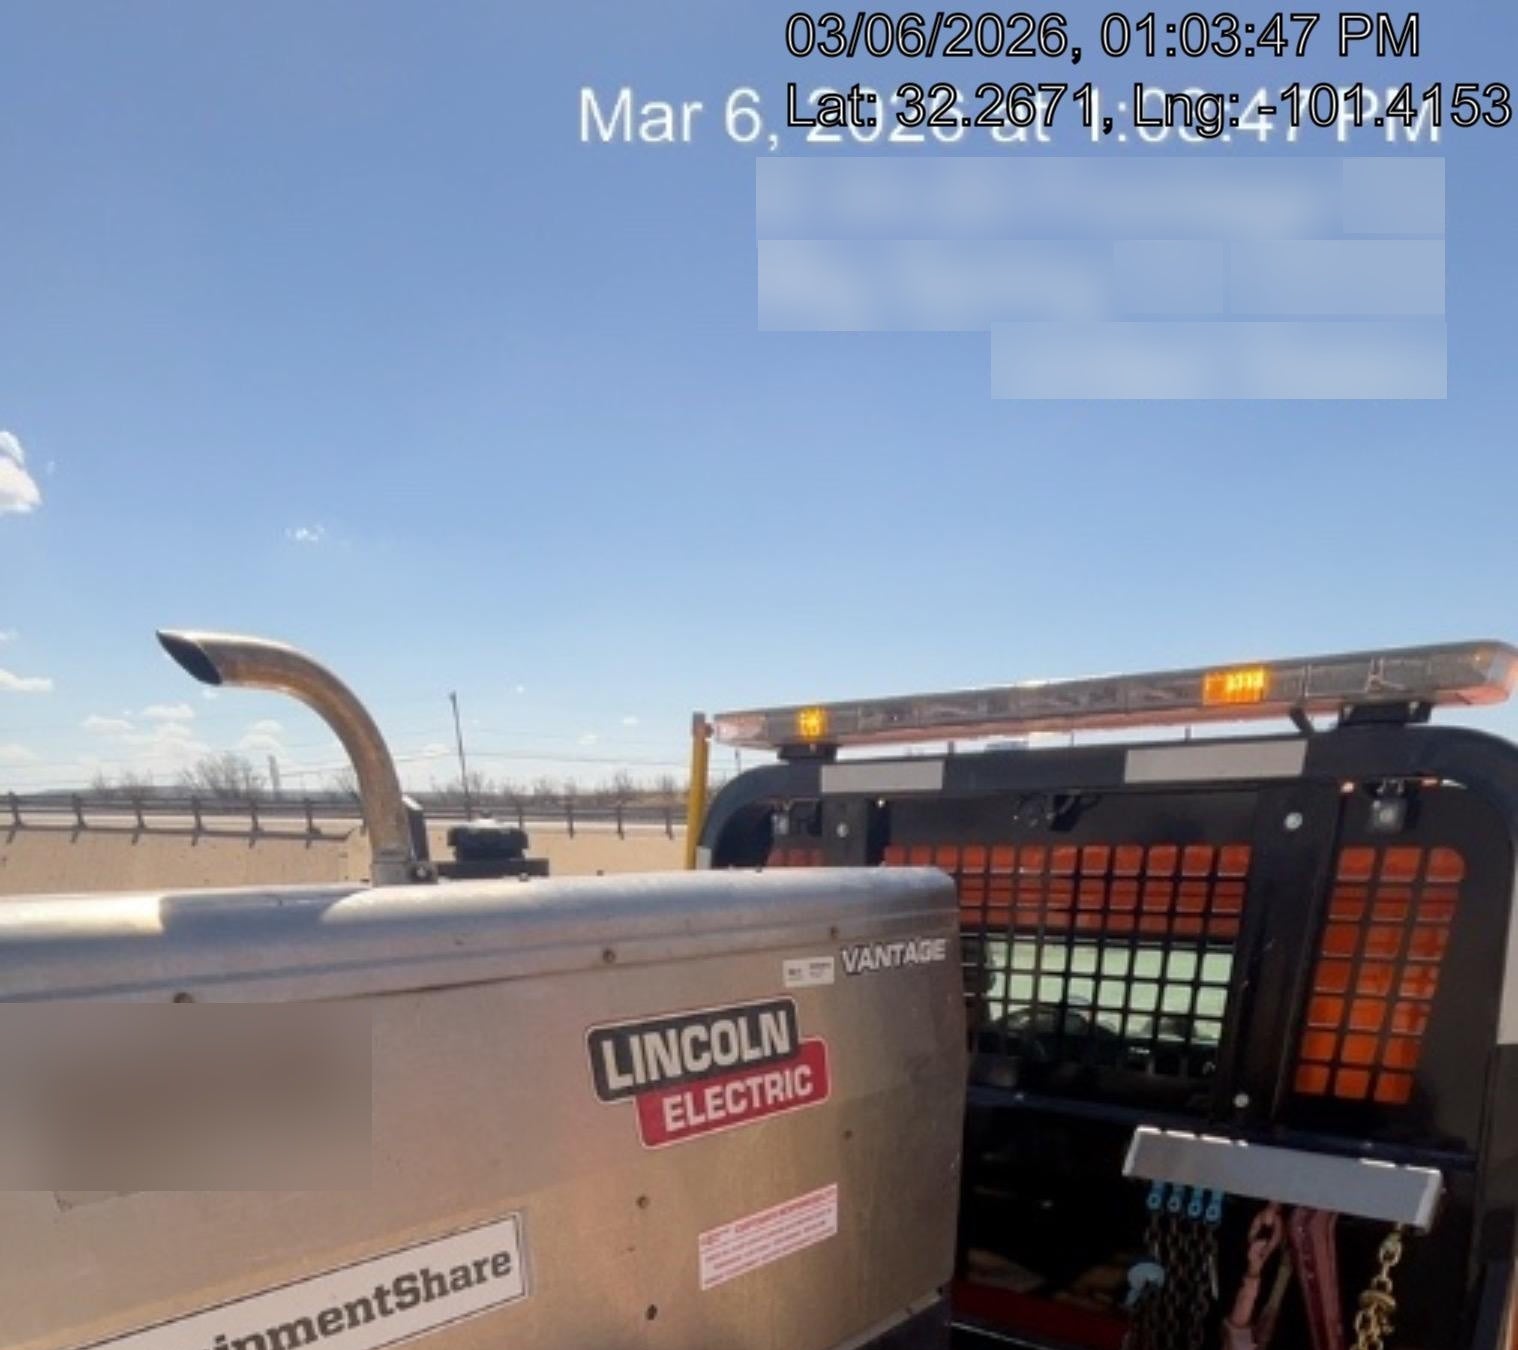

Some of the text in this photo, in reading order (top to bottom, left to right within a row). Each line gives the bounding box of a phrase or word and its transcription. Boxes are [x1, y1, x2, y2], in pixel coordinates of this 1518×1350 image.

[841, 938, 947, 975] VANTAGE
[602, 1010, 790, 1090] LINCOLN
[662, 1064, 814, 1132] ELECTRIC
